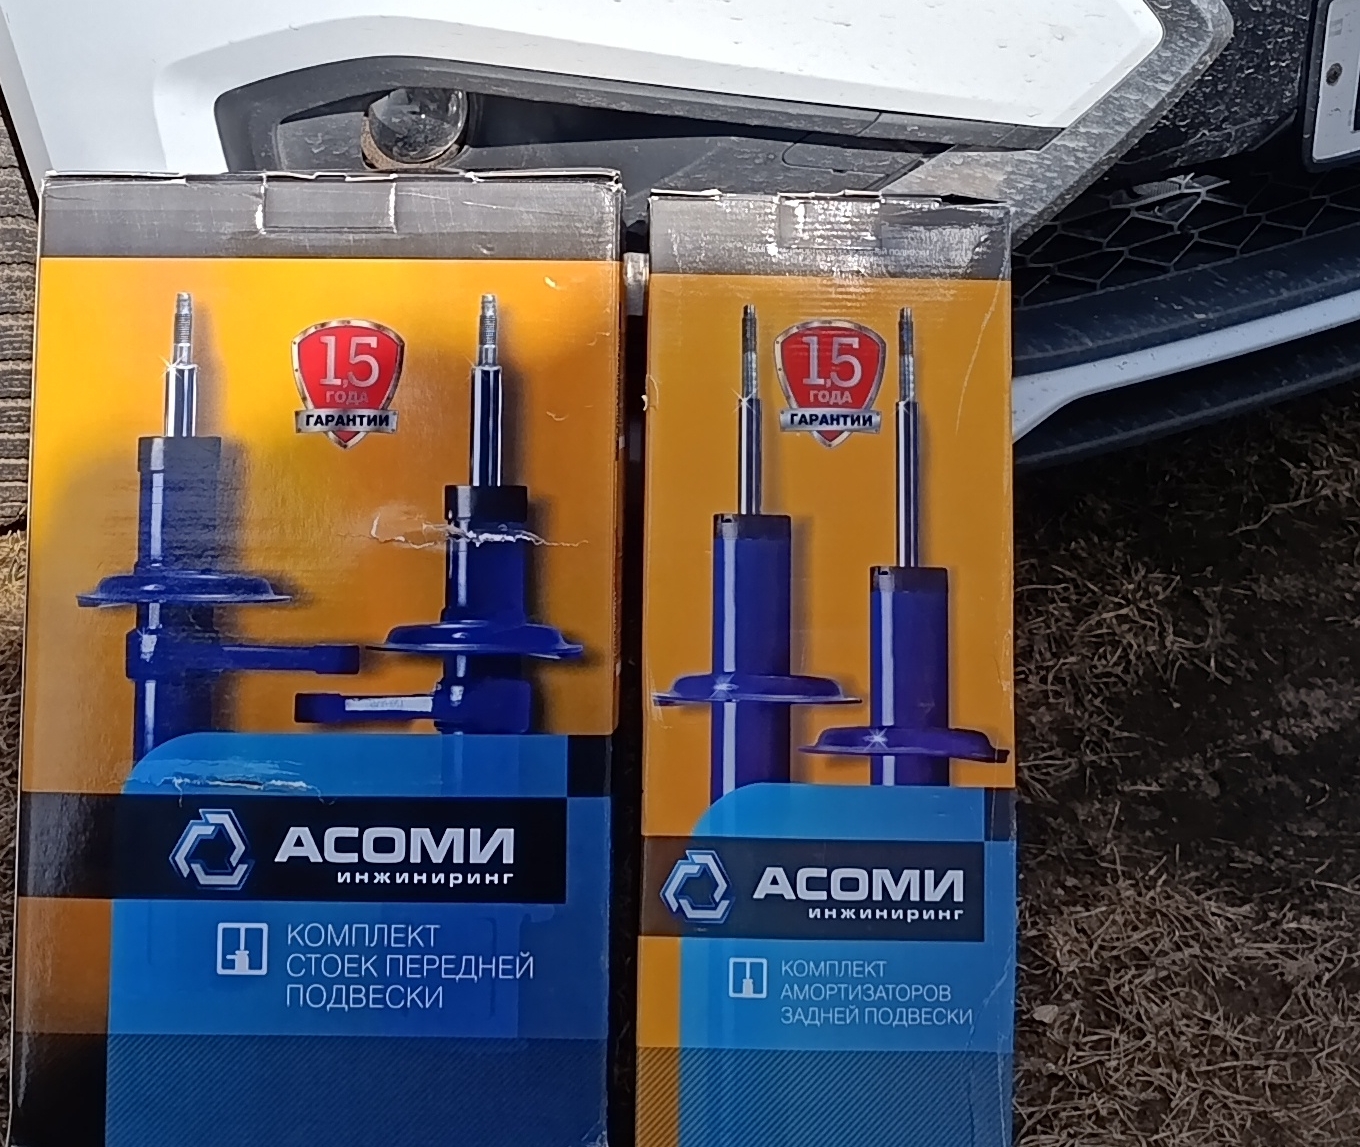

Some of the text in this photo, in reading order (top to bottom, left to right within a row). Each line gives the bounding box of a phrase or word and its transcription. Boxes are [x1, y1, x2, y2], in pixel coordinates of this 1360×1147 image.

[319, 335, 380, 389] 1,5
[801, 336, 862, 389] 1,5
[325, 390, 369, 406] ГОДА
[809, 390, 853, 405] ГОДА
[305, 414, 390, 427] ГАРАНТИИ
[790, 413, 873, 427] ГАРАНТИИ
[274, 826, 515, 865] АСОМИ
[337, 871, 514, 888] инжиниринг
[752, 866, 964, 902] АСОМИ
[808, 908, 964, 923] инжиниринг
[287, 923, 441, 948] КОМПЛЕКТ
[286, 951, 534, 983] СТОЕК ПЕРЕДНЕЙ
[781, 959, 888, 978] КОМПЛЕКТ
[286, 983, 443, 1013] ПОДВЕСКИ
[780, 983, 952, 1002] АМОРТИЗАТОРОВ
[780, 1005, 974, 1028] ЗАДНЕЙ ПОДВЕСКИ
